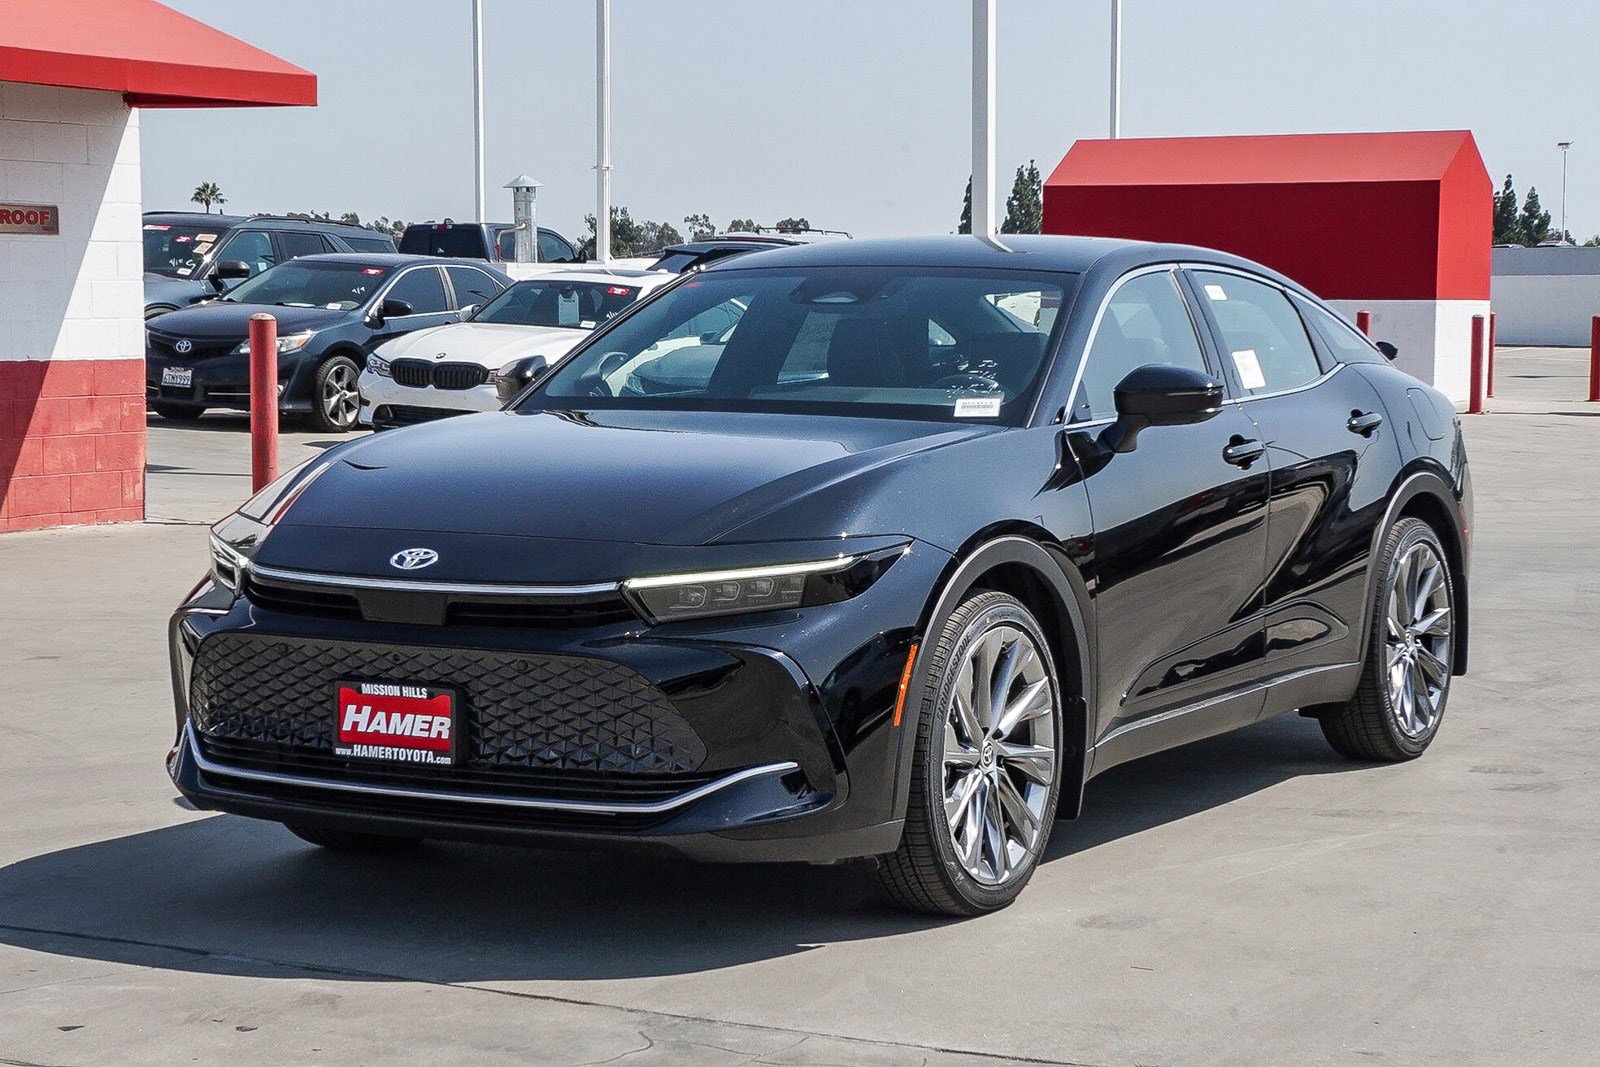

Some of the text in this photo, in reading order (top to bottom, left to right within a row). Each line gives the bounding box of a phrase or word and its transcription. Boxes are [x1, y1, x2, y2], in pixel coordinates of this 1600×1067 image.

[0, 209, 50, 225] ROOF
[361, 683, 428, 699] MISSION HILLS
[342, 704, 452, 739] HAMER
[335, 744, 451, 765] www.HAMERTOYOTA.com
